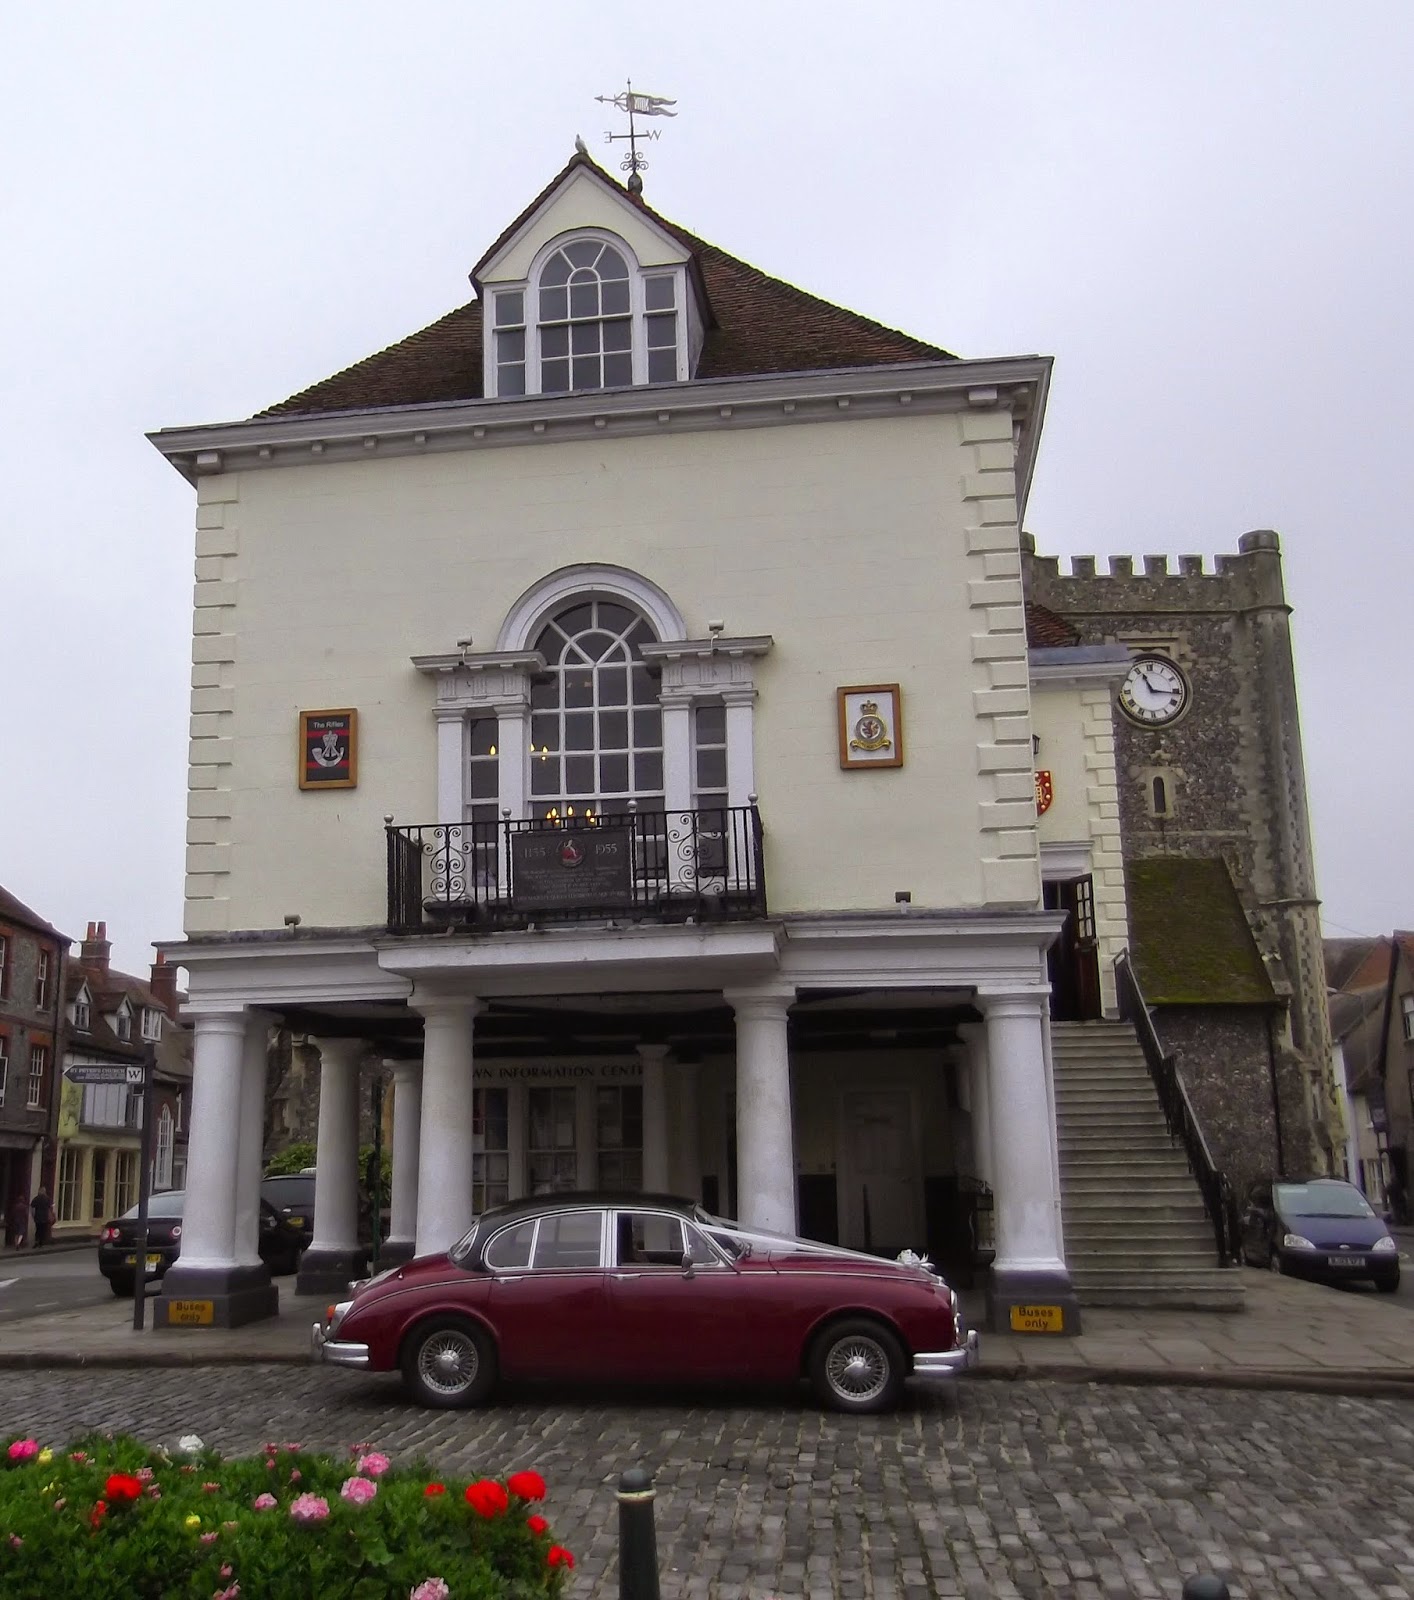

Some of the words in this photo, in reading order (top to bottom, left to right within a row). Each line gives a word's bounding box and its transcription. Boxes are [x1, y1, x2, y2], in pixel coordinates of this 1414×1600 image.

[646, 130, 662, 140] W
[524, 847, 546, 858] 1155
[595, 843, 618, 855] 1955
[128, 1071, 141, 1079] W
[500, 1067, 594, 1079] INFORMATION
[177, 1302, 206, 1311] Buses
[1019, 1307, 1053, 1317] Buses
[1025, 1319, 1048, 1329] only
